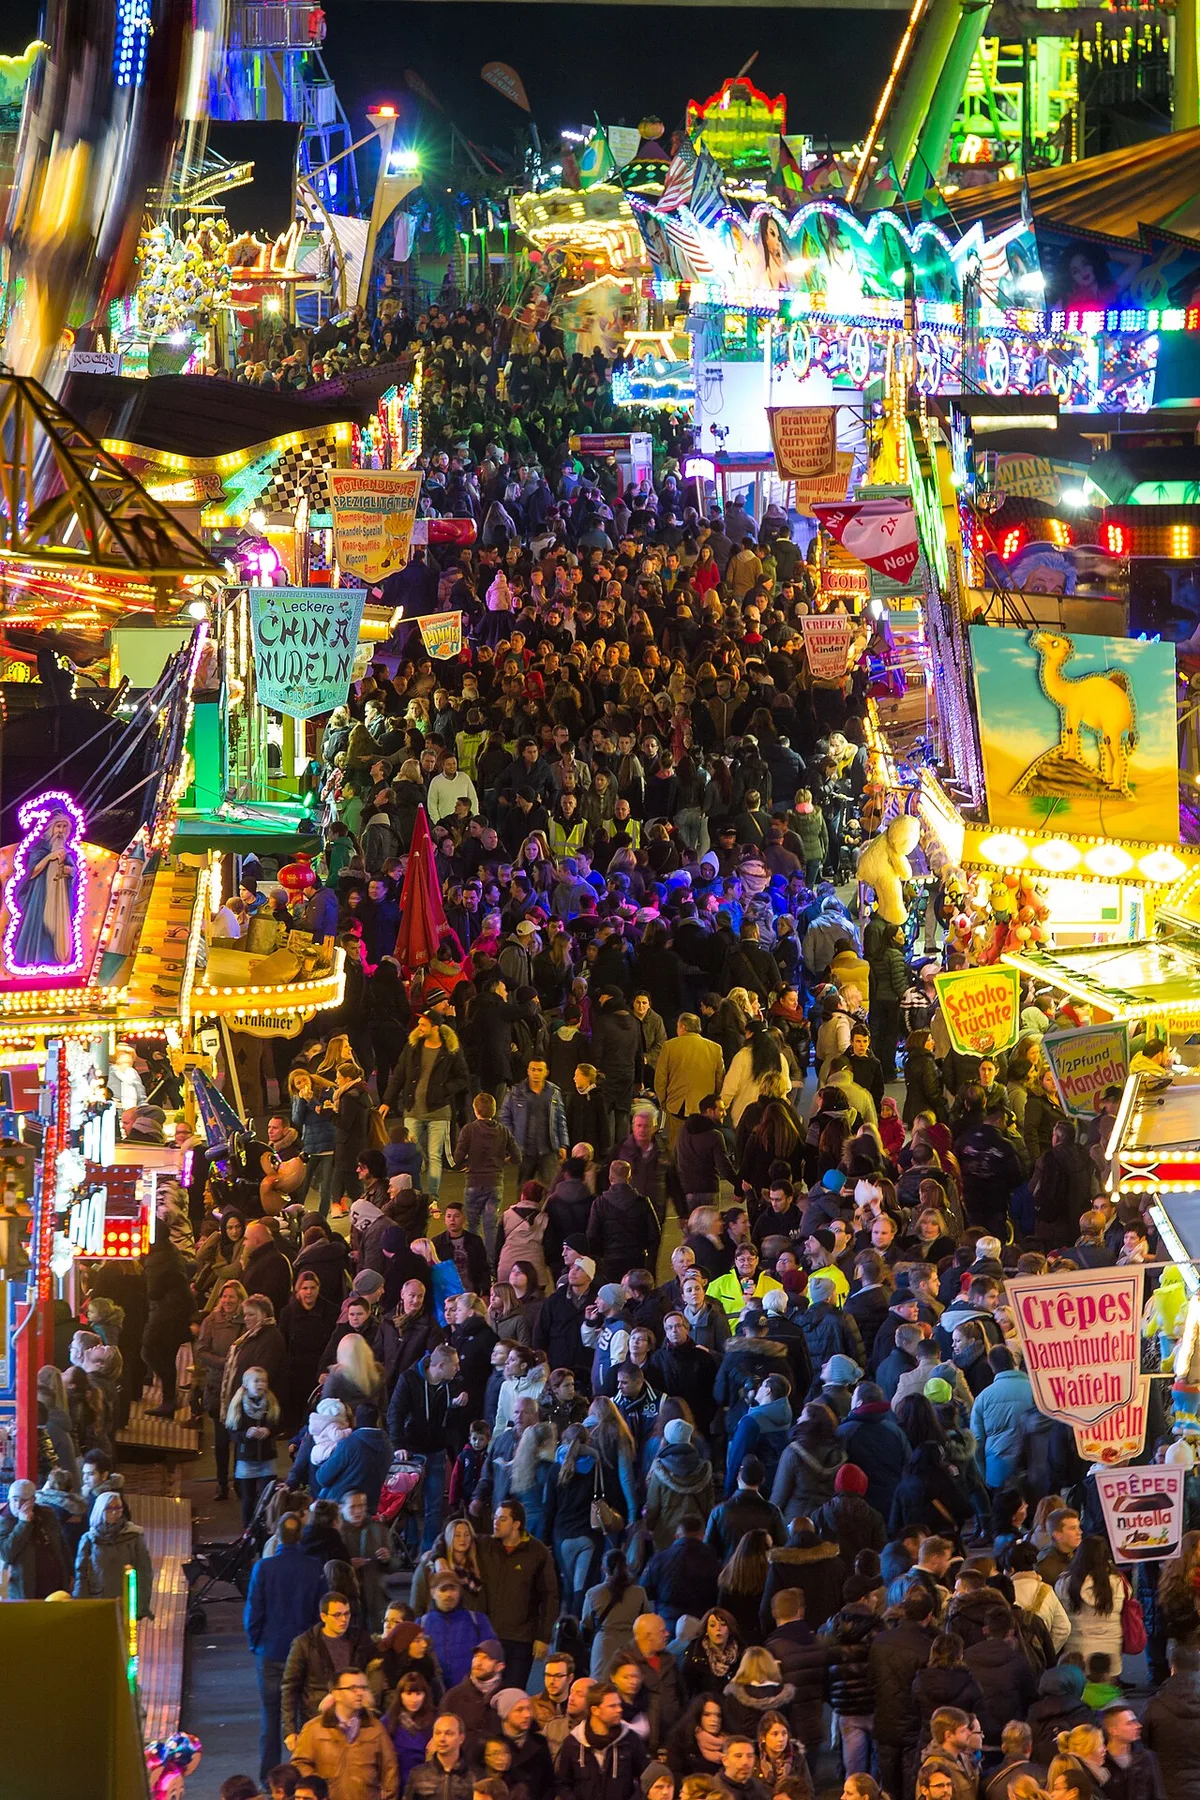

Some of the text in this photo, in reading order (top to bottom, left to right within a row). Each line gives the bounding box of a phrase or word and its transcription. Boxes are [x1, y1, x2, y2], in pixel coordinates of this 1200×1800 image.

[782, 447, 829, 458] Spareribs
[791, 458, 823, 468] Steaks
[335, 477, 416, 498] HOLLÄNDISCHE
[333, 495, 416, 511] SPEZIALITÄTEN
[336, 525, 382, 539] Frikandel-Spezial
[345, 554, 367, 566] Kipcorn
[884, 551, 915, 572] Neu
[827, 575, 868, 589] GOLD
[282, 600, 335, 615] Leckere
[258, 615, 351, 649] CHINA
[812, 645, 844, 654] kinder
[259, 650, 351, 686] NUDELN
[812, 664, 845, 674] nutella
[945, 984, 1013, 1019] Schoko-
[954, 1005, 1011, 1037] früchte
[1058, 1059, 1127, 1100] Mandeln
[1022, 1291, 1131, 1330] Crêpes
[1025, 1331, 1136, 1371] Dampfnudeln
[1049, 1372, 1122, 1408] Waffeln
[1079, 1404, 1144, 1441] affeln
[1103, 1473, 1178, 1499] CRÊPES
[1117, 1510, 1172, 1529] nutella
